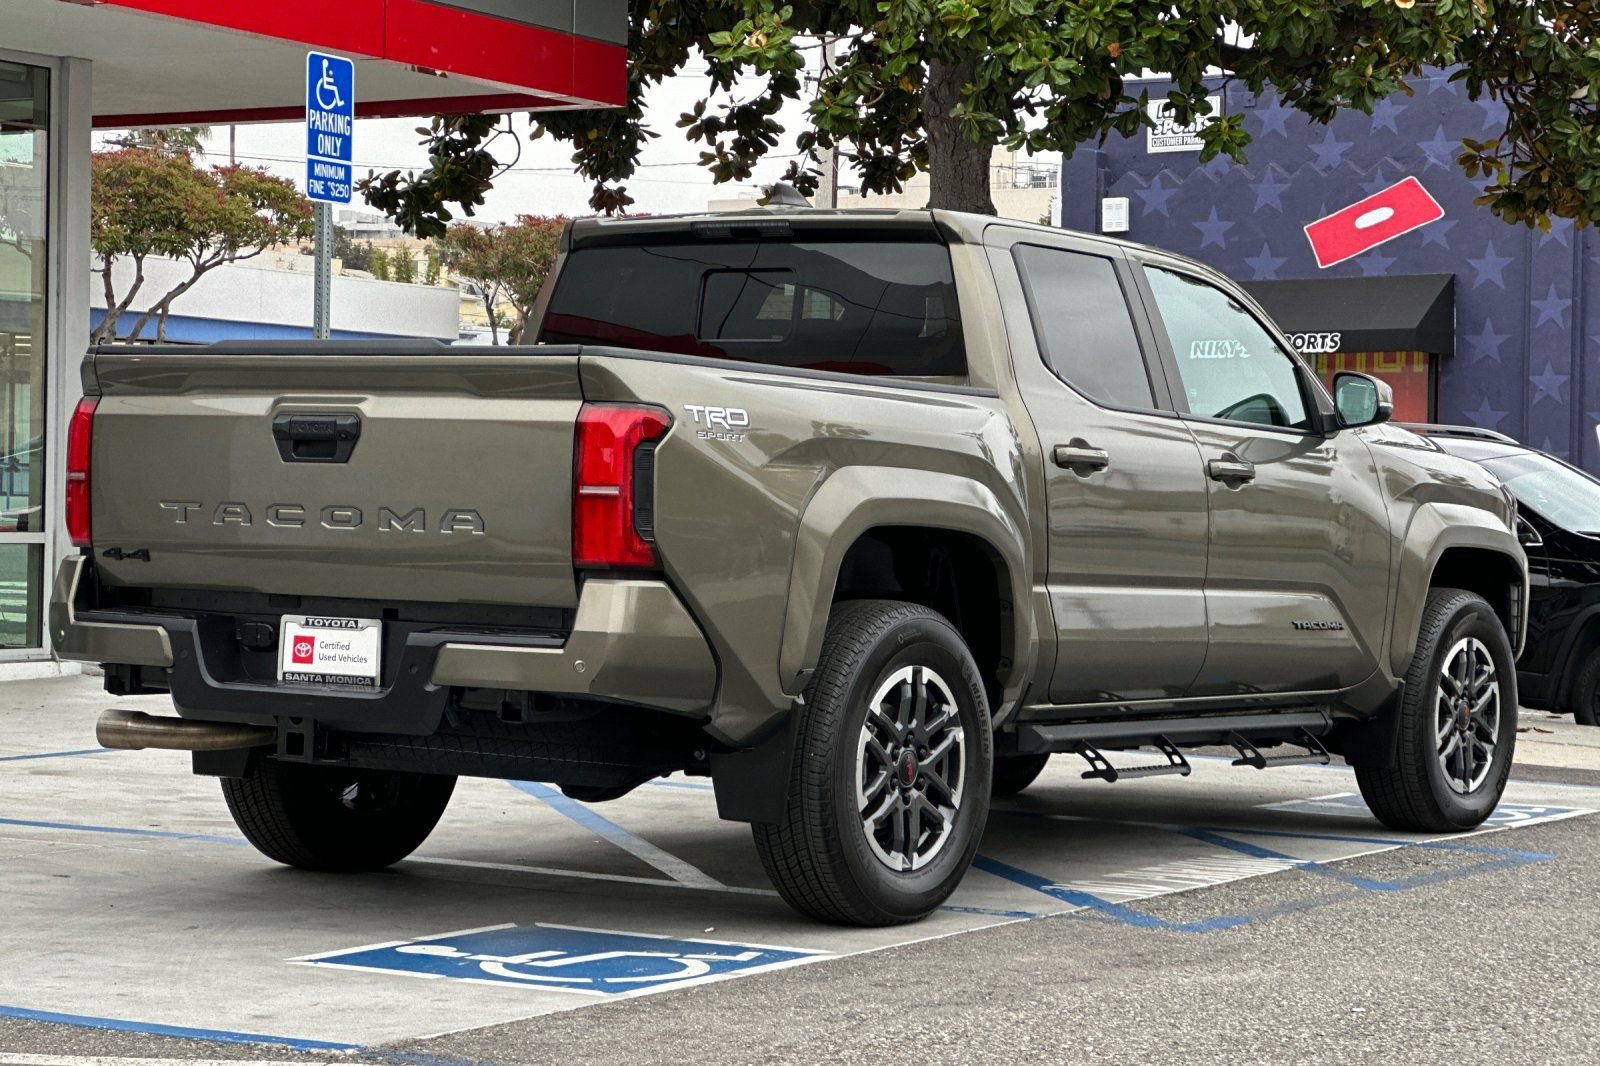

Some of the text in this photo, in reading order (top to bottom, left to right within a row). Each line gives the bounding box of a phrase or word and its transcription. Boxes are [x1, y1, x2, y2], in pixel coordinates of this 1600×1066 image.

[309, 108, 350, 136] PARKING
[317, 133, 342, 157] ONLY
[1152, 136, 1183, 147] CUSTOMER
[314, 162, 345, 181] MINIMUM
[309, 179, 325, 195] FINE
[1284, 332, 1341, 352] ORTS
[684, 404, 750, 430] TRD
[696, 431, 745, 442] SPORT
[159, 501, 485, 534] TACOMA
[307, 618, 357, 628] TOYOTA
[319, 640, 351, 651] Certified
[318, 653, 368, 664] Used Vehicles
[285, 673, 372, 685] SANTA MONICA
[971, 682, 990, 754] MICHELIN
